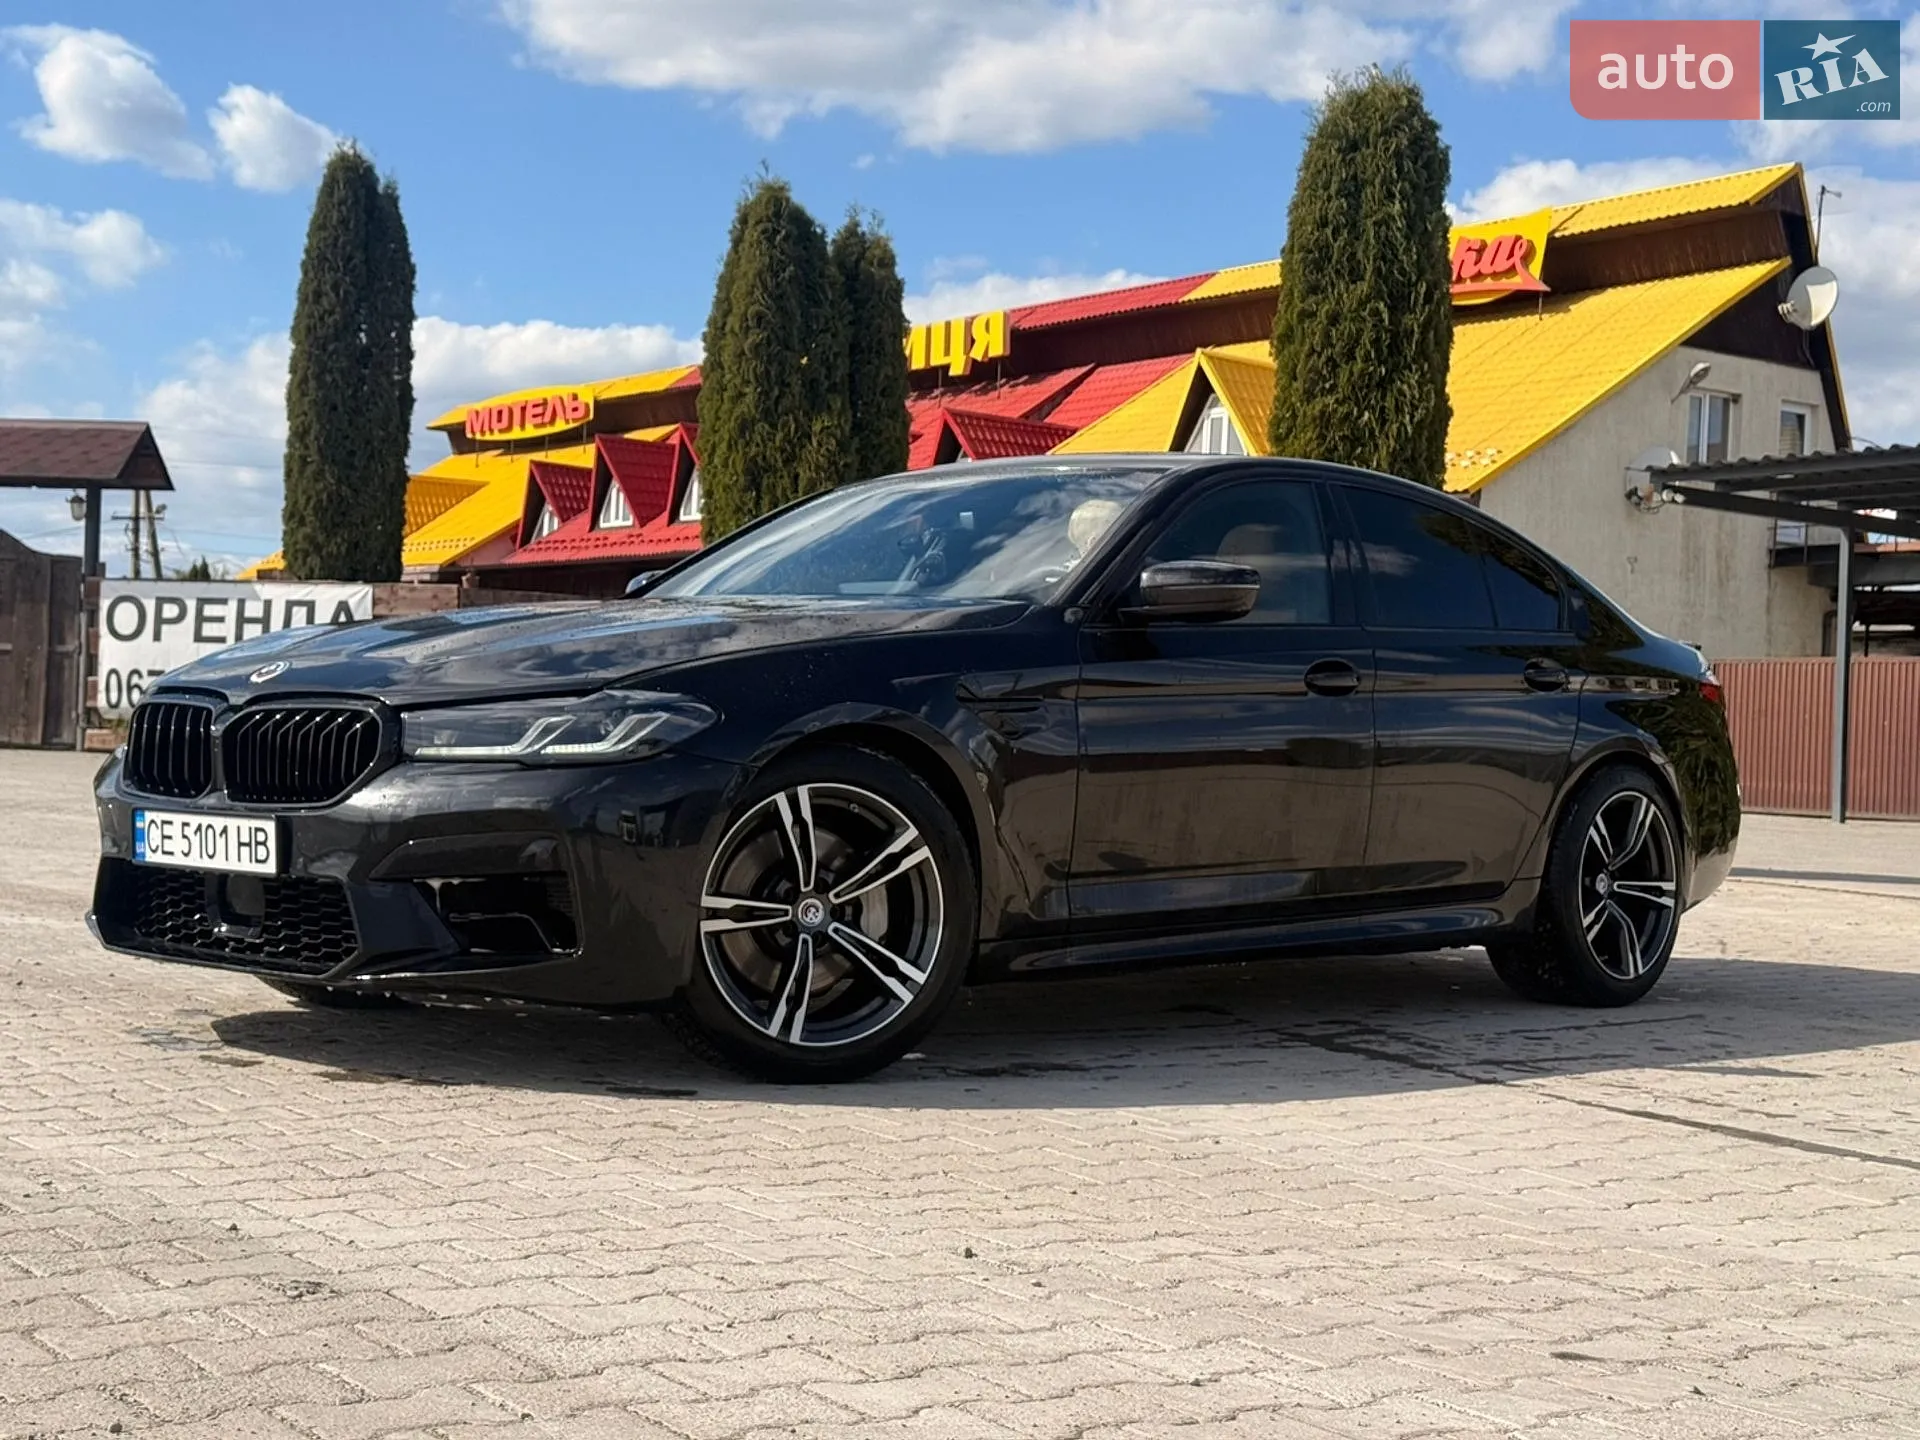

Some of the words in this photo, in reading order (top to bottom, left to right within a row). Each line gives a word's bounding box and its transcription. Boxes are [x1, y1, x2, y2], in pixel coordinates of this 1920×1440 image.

[466, 392, 586, 436] МОТЕЛЬ
[147, 819, 175, 856] CE
[181, 822, 229, 862] 5101
[237, 825, 270, 864] HB
